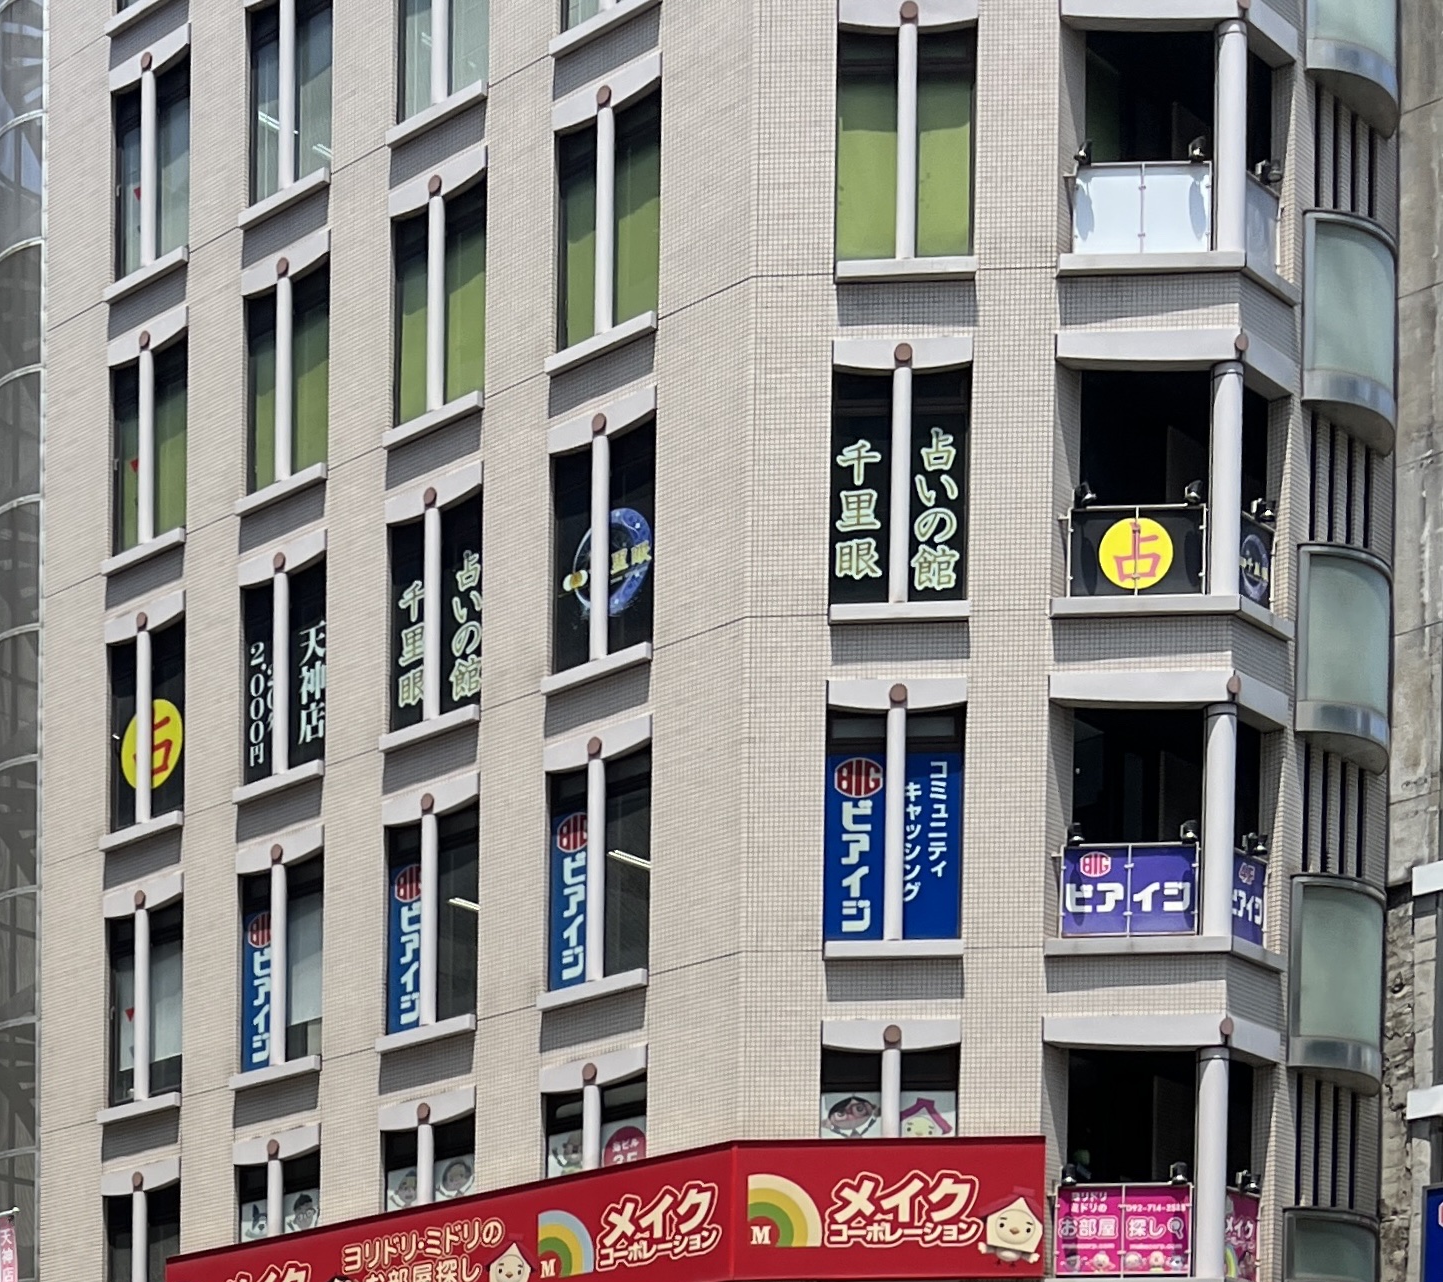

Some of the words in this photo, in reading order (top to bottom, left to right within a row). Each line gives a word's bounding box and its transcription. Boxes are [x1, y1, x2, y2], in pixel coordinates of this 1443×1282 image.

[835, 438, 882, 580] 千里眼
[911, 427, 960, 591] 占いの館
[450, 550, 482, 702] 占いの館
[299, 621, 326, 745] 天神店
[904, 782, 922, 902] キャッシング
[928, 761, 949, 878] コミュニティ
[841, 800, 873, 933] ビアイジ
[1065, 882, 1191, 913] ビアイジ
[562, 850, 587, 981] ビアイジ
[603, 1183, 719, 1247] メイク
[751, 1225, 771, 1245] M
[829, 1220, 983, 1245] コーポレーション
[832, 1171, 977, 1224] メイク
[1, 1229, 15, 1282] 天神店
[540, 1258, 556, 1279] M
[598, 1227, 720, 1269] コーポレーション
